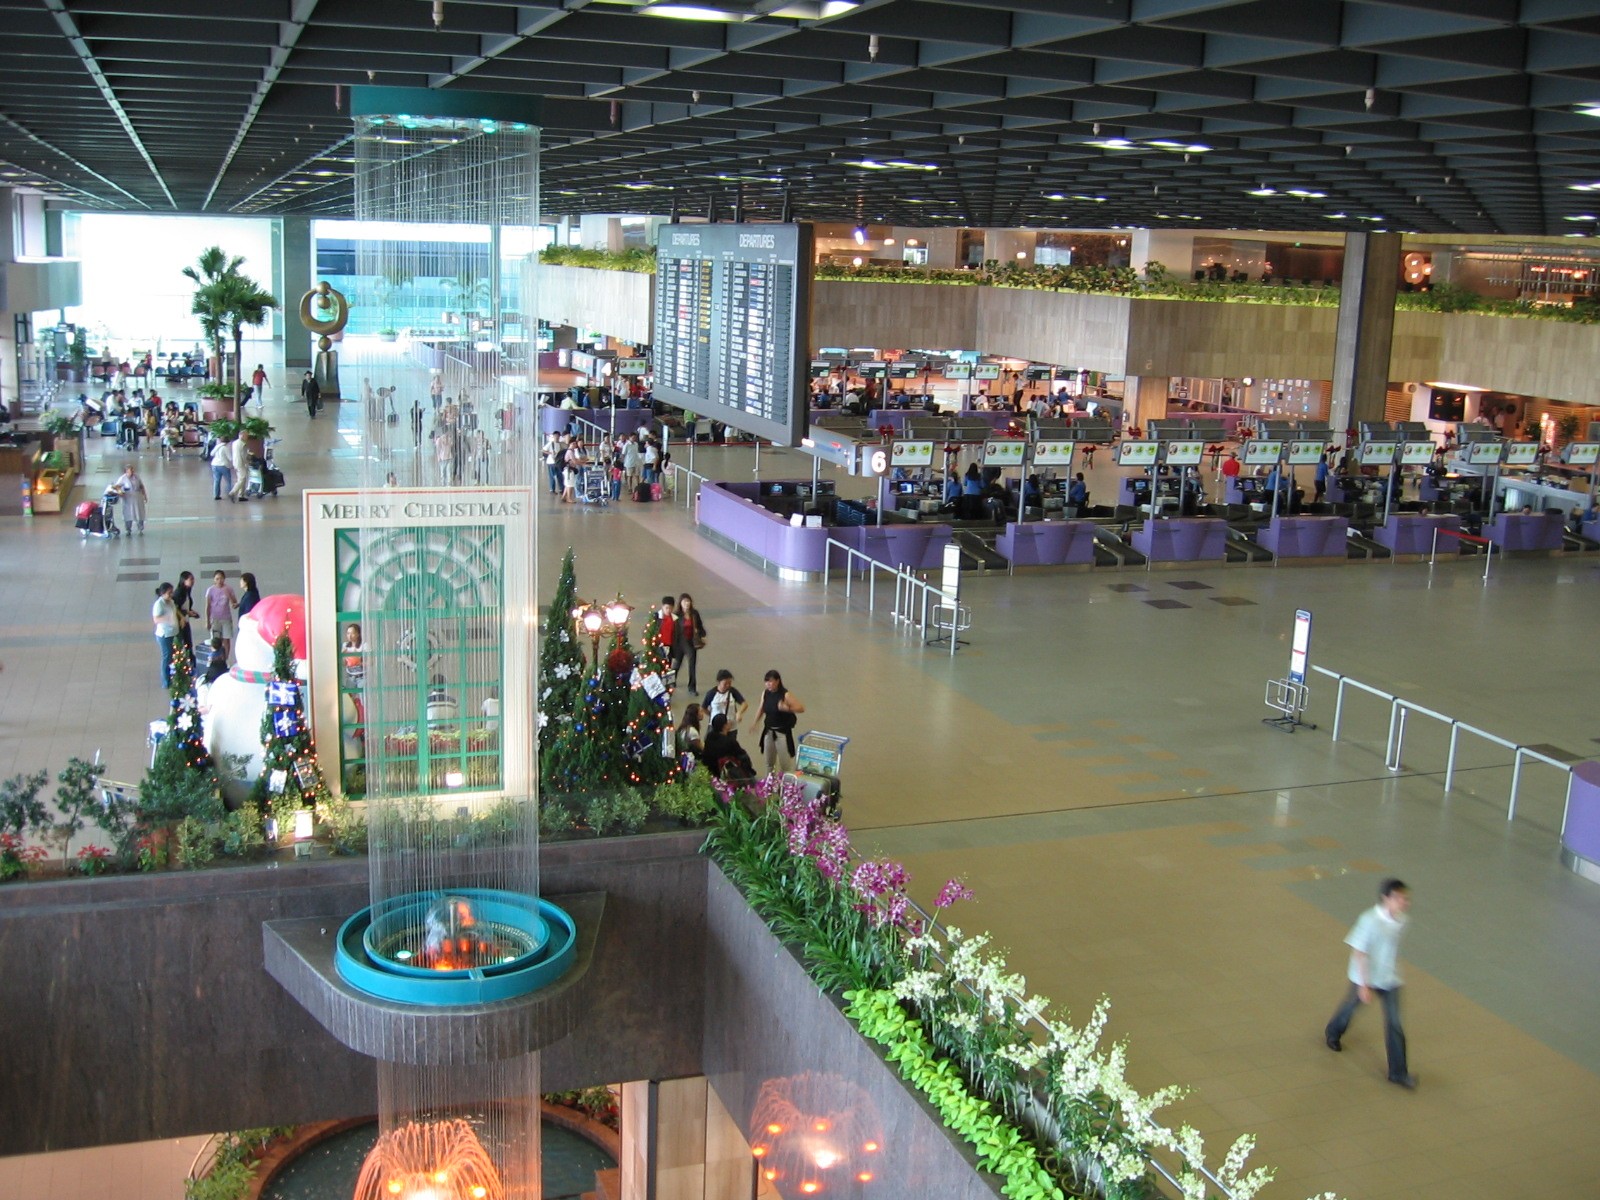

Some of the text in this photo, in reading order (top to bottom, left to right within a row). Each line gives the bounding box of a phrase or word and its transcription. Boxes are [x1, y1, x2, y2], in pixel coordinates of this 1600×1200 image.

[672, 233, 700, 246] DEPARTURES
[739, 233, 775, 249] DEPARTURES
[601, 362, 612, 376] 4
[871, 451, 886, 473] 6
[321, 502, 521, 519] MERRY CHRISTMAS
